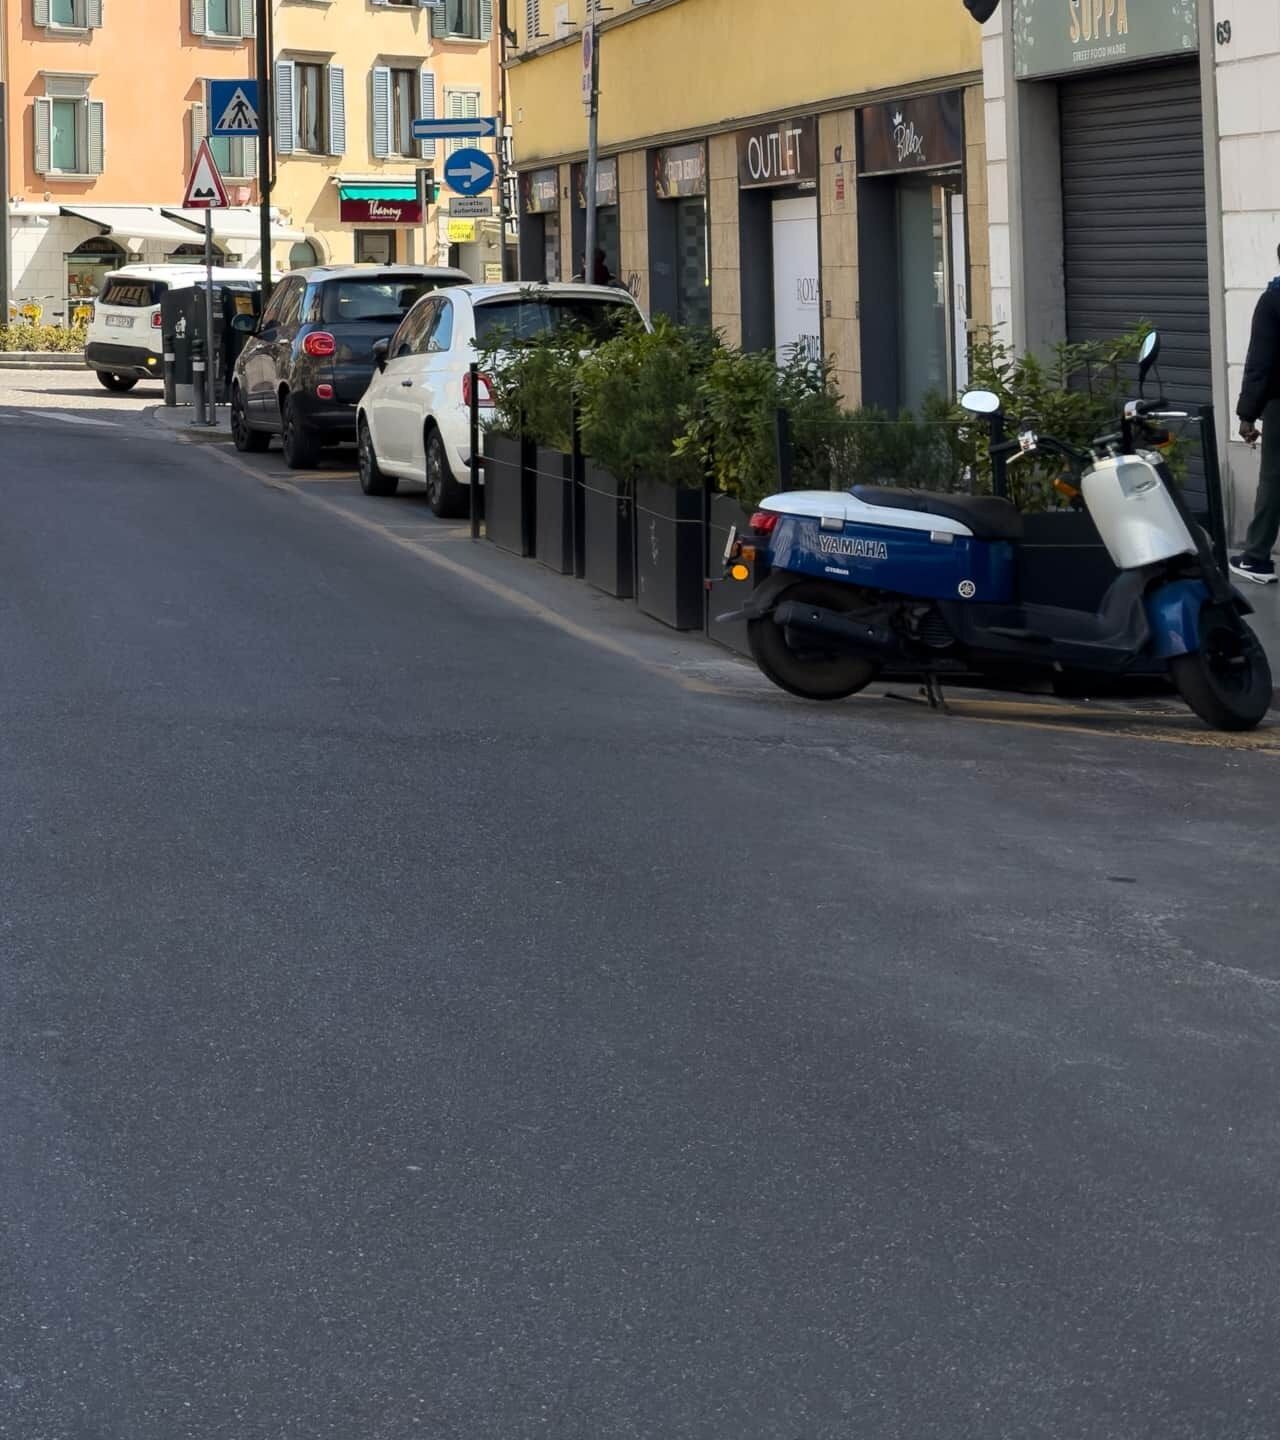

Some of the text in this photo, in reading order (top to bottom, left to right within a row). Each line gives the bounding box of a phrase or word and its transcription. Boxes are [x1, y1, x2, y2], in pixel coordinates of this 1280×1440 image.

[1216, 20, 1231, 45] 69
[747, 128, 803, 180] OUTLET
[818, 535, 888, 559] YAMAHA
